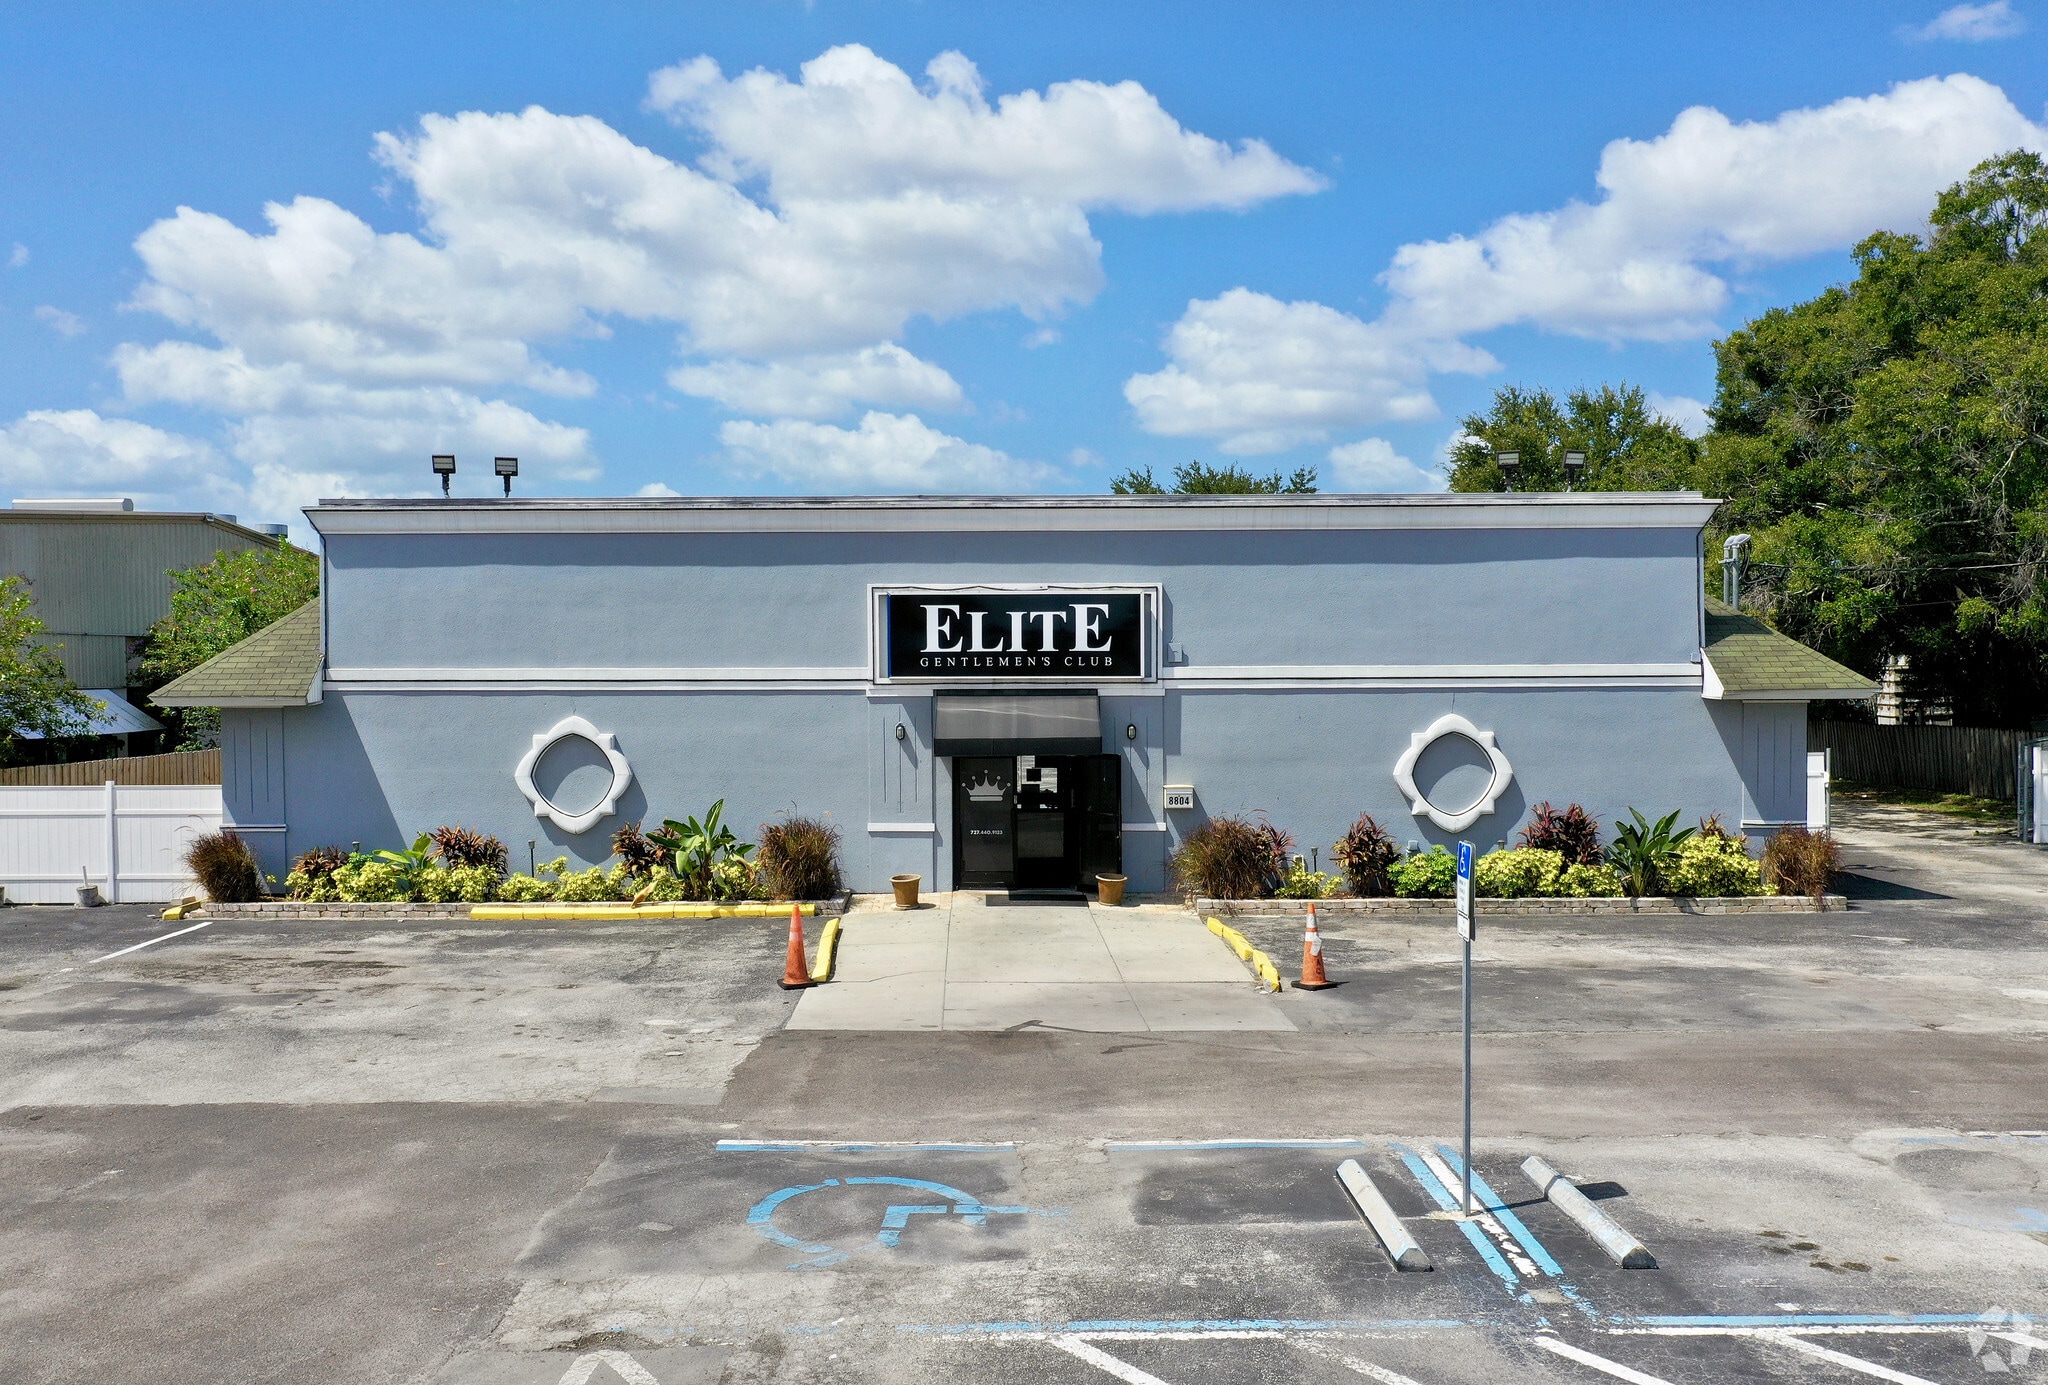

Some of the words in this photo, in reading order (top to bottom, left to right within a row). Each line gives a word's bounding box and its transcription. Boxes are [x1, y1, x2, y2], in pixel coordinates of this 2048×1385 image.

[919, 603, 1113, 653] ELITE
[920, 656, 1052, 668] GENTLEMEN'S
[1064, 656, 1113, 667] CLUB
[1168, 796, 1189, 805] 8804
